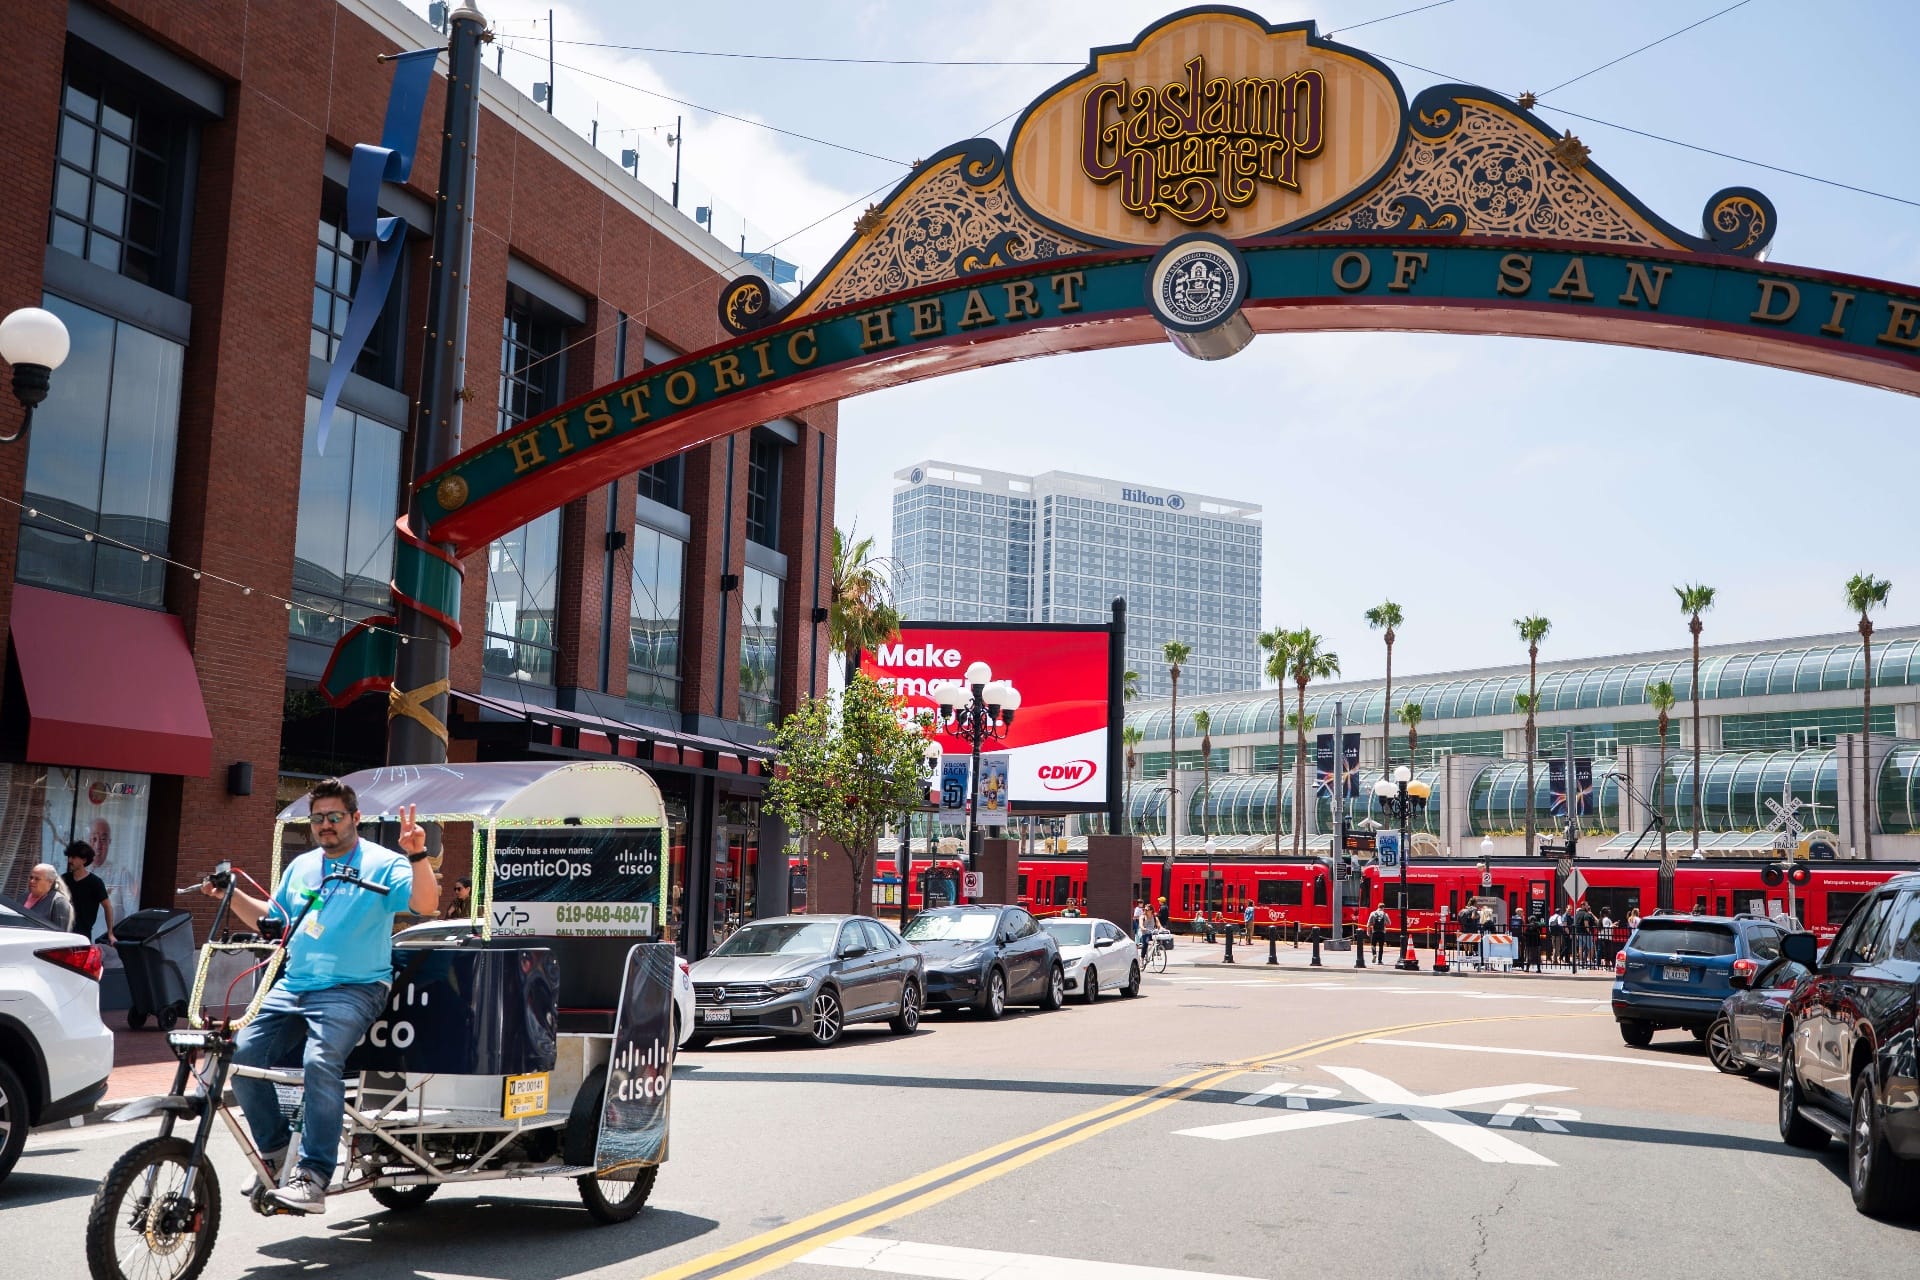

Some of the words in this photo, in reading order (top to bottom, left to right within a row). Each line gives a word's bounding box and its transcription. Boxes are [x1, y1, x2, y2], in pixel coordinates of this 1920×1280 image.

[1081, 55, 1325, 186] Gaslamp
[1120, 136, 1285, 222] Quarter
[506, 328, 820, 474] HISTORIC
[855, 270, 1087, 349] HEART
[1331, 250, 1428, 292] OF
[1497, 253, 1672, 307] SAN
[1750, 278, 1920, 348] DIE
[1122, 488, 1164, 506] Hilton
[877, 643, 961, 667] Make
[1038, 765, 1084, 779] CDW
[526, 846, 541, 855] has
[568, 847, 593, 855] name:
[493, 905, 530, 927] VIP
[556, 905, 649, 923] 619-648-4847
